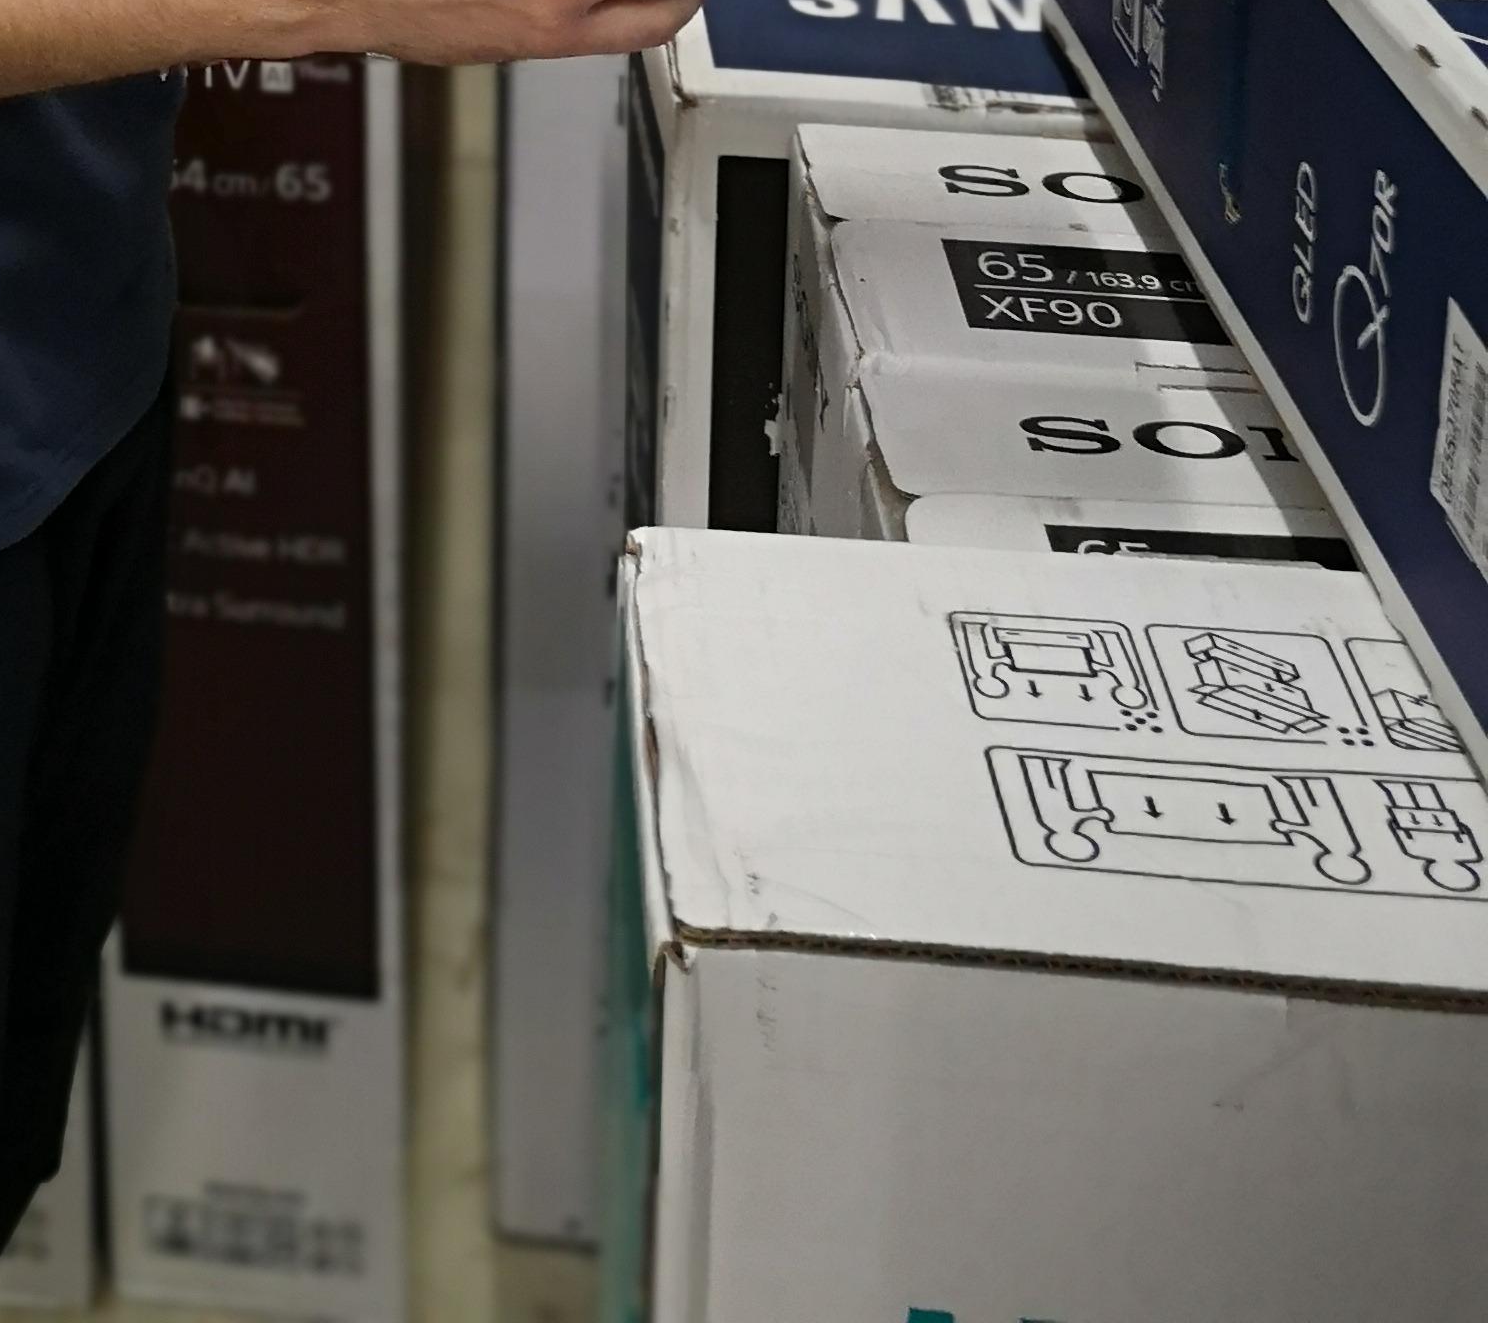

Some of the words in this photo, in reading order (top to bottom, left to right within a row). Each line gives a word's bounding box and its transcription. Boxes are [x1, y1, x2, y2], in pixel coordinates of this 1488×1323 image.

[275, 162, 332, 203] 65
[1292, 161, 1318, 325] QLED
[977, 250, 1055, 284] 65
[1086, 270, 1162, 291] 163.9
[979, 294, 1123, 329] XF90
